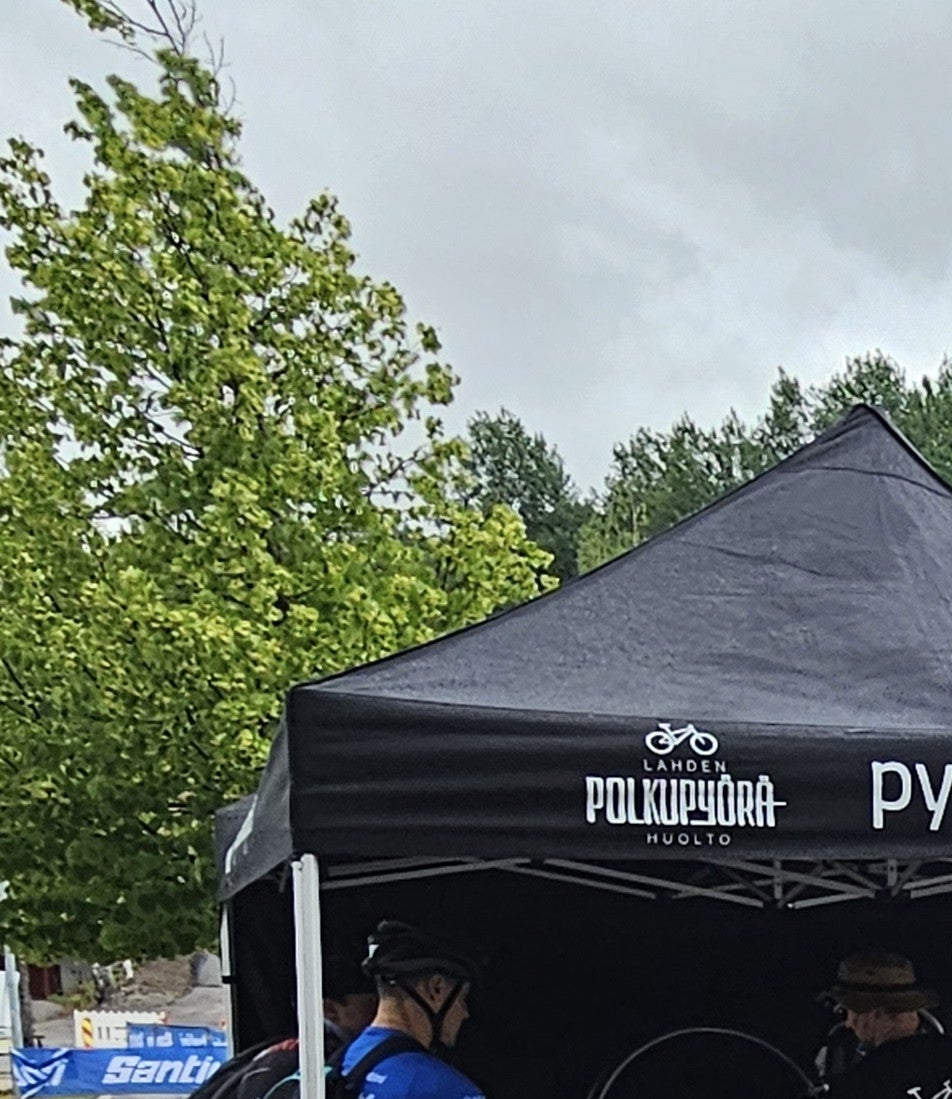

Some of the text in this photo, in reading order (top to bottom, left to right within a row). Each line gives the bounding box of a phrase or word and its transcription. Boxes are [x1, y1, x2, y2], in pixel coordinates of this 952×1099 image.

[643, 758, 727, 774] LAHDEN
[584, 773, 788, 828] POLKUPYÖRÄ
[646, 832, 732, 846] HUOLTO
